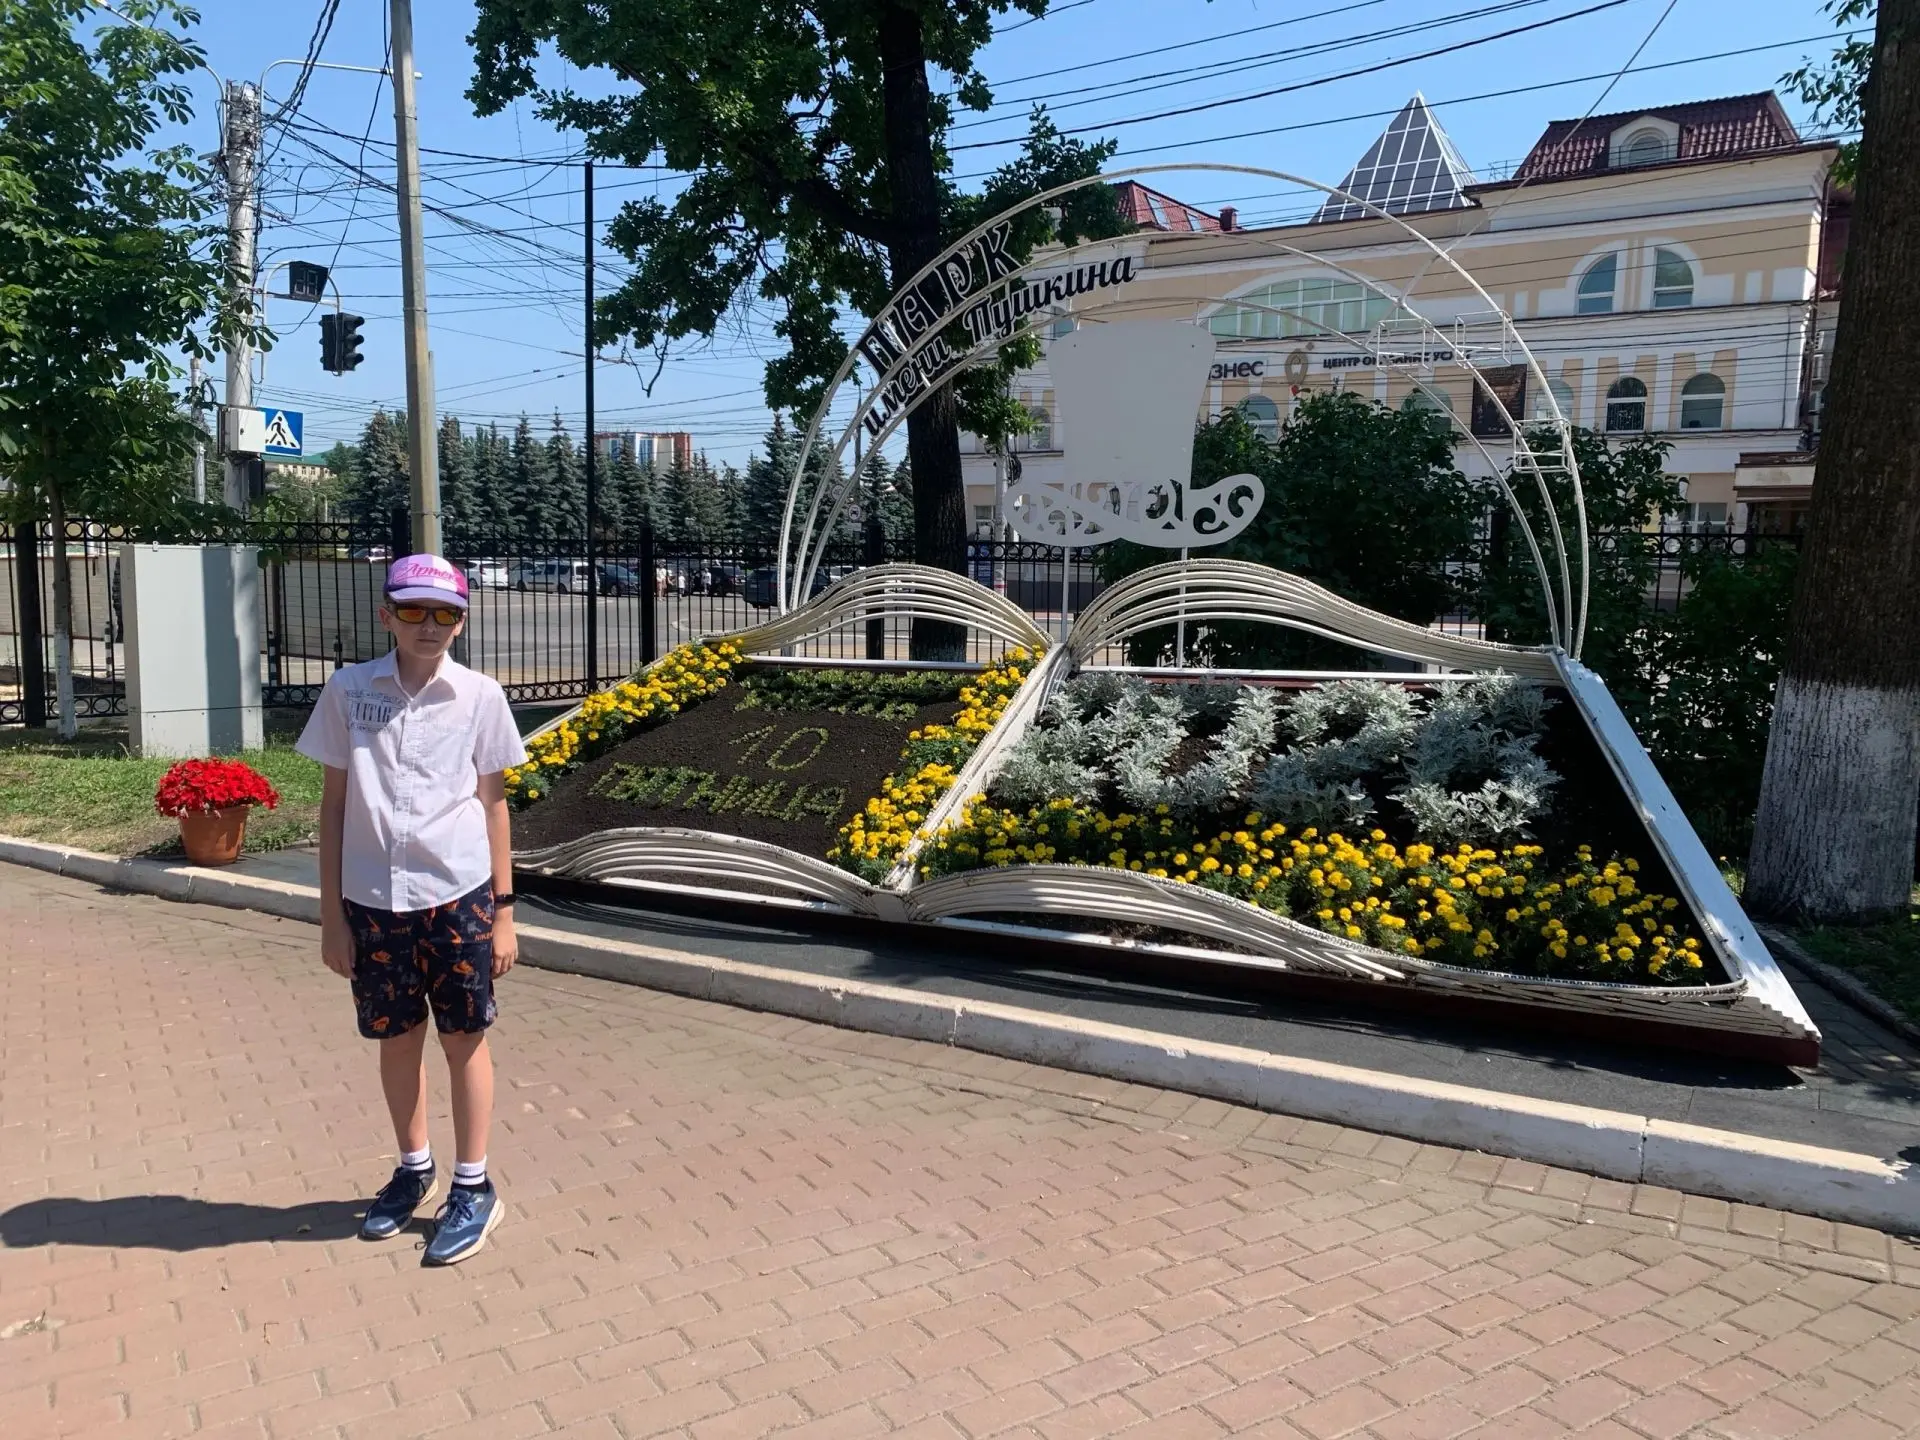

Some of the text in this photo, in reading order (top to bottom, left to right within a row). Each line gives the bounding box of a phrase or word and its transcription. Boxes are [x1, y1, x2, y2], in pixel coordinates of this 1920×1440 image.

[863, 256, 1136, 437] имени Пушкина
[1208, 361, 1264, 380] знес
[1323, 358, 1360, 369] ЦЕНТР
[728, 724, 830, 772] 10
